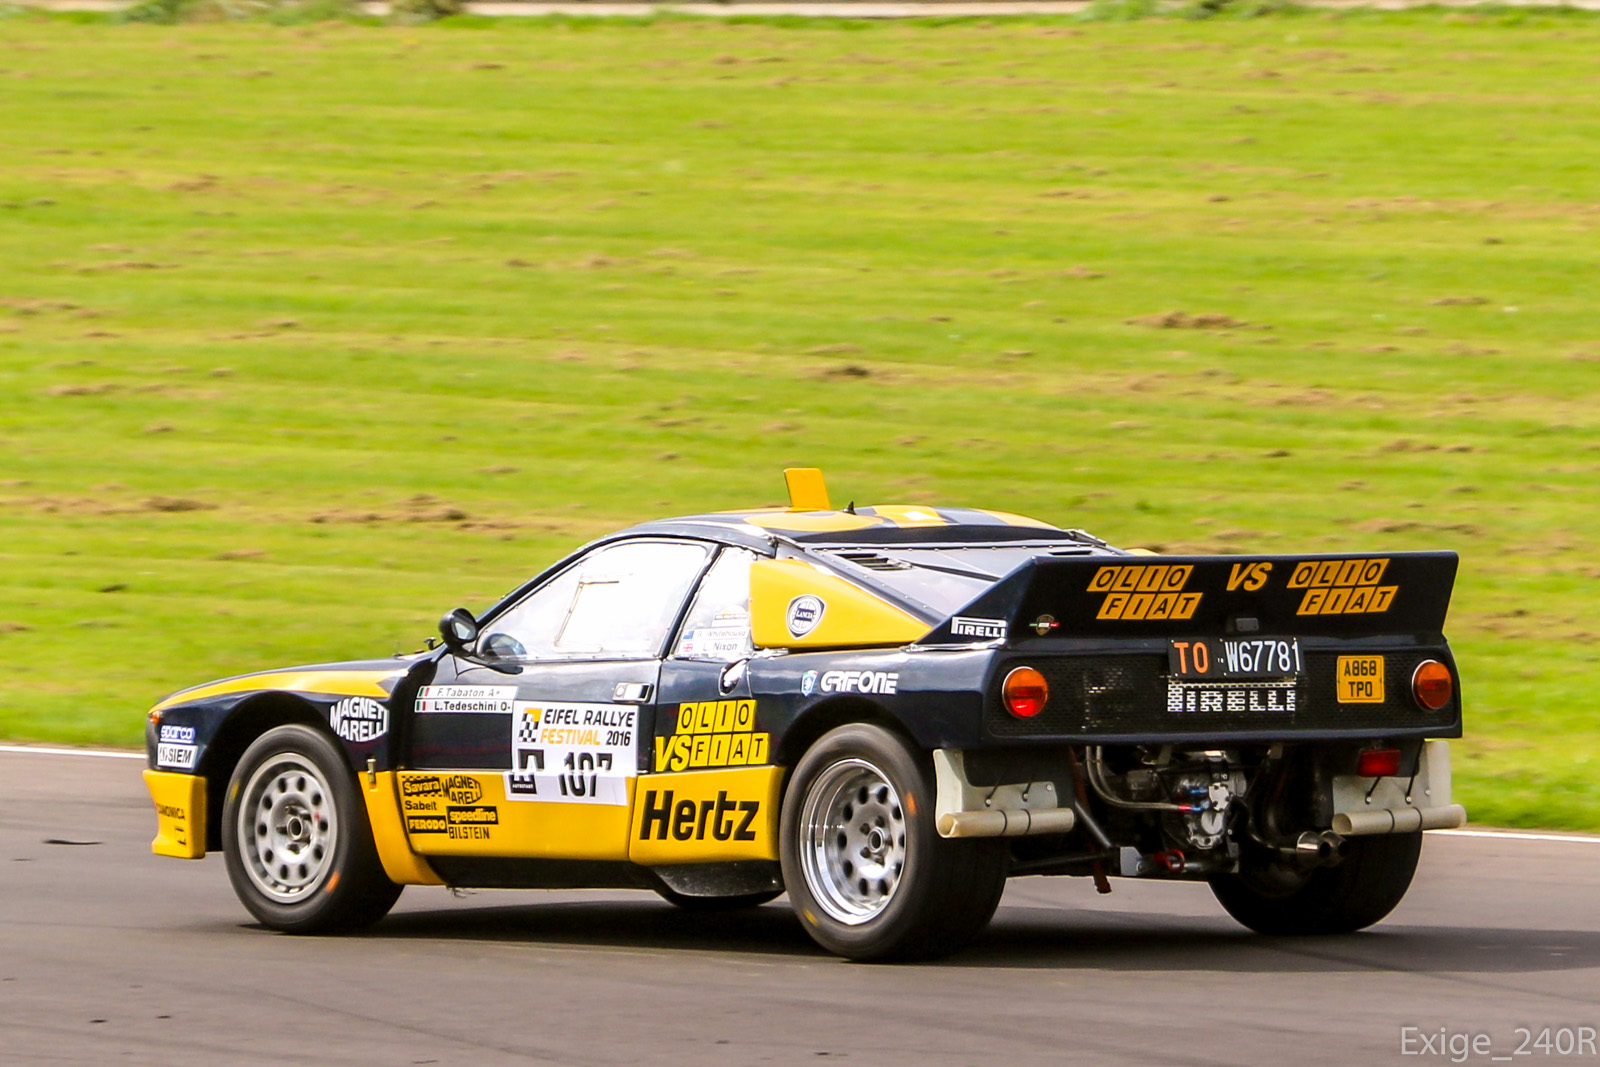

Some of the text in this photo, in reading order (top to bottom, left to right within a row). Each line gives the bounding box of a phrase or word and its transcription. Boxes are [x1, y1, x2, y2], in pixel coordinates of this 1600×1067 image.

[1092, 566, 1190, 590] OLIO
[1226, 562, 1272, 591] VS
[1292, 560, 1385, 585] OLIO
[1103, 594, 1199, 617] FIAT
[1301, 588, 1395, 613] FIAT
[951, 617, 1006, 637] PIRELLI
[713, 642, 738, 651] Nixon
[1174, 640, 1300, 673] TO W67781
[1344, 660, 1377, 676] A868
[821, 670, 899, 694] GRIFONE
[1348, 681, 1373, 697] TPO
[330, 697, 389, 720] MAGNETI
[434, 701, 497, 711] L.Tedeschini
[1167, 682, 1296, 712] PIRELLI
[544, 709, 635, 728] EIFEL RALLYE
[679, 701, 753, 731] OLIO
[161, 725, 192, 740] sparco
[330, 718, 389, 742] MARELLI
[540, 728, 631, 746] FESTIVAL 2016
[655, 735, 766, 771] VS FIAT
[558, 752, 613, 797] 107
[408, 819, 446, 830] FERODO
[639, 790, 760, 841] Hertz
[449, 826, 490, 839] BILSTEIN
